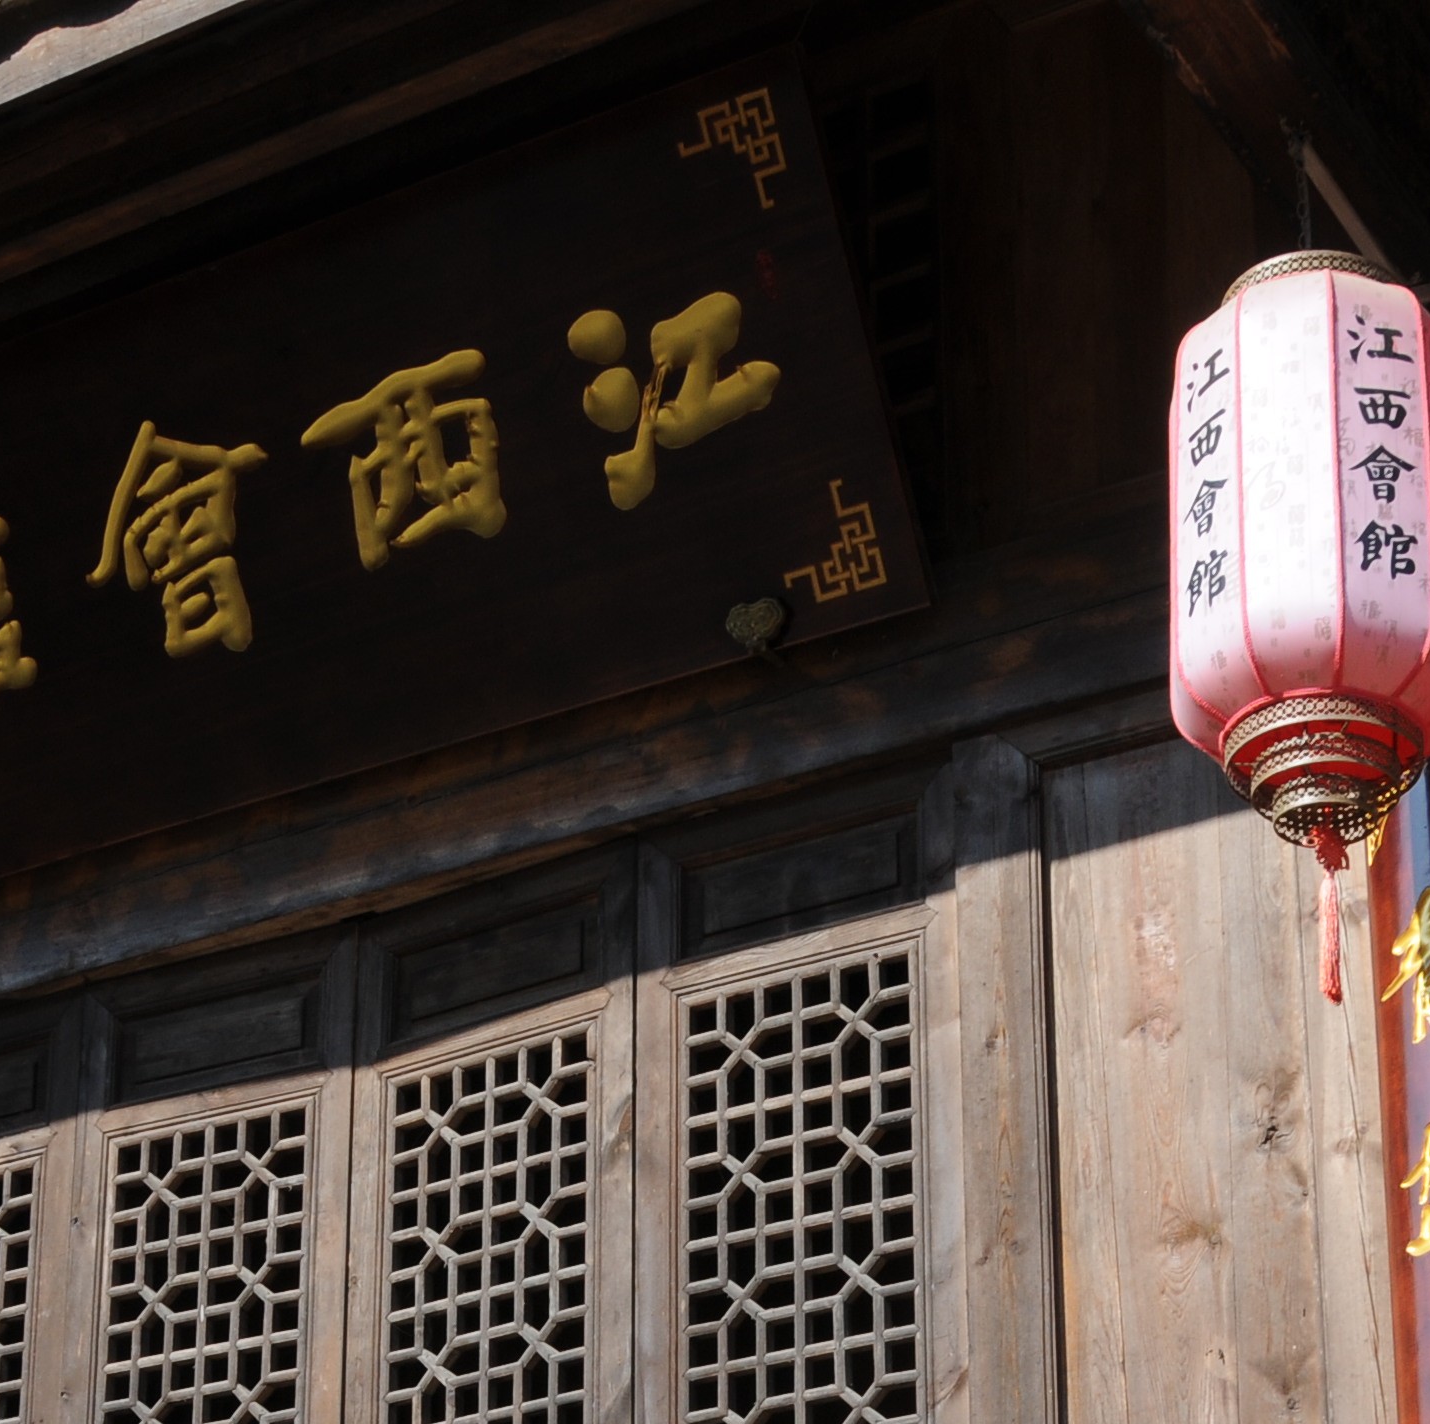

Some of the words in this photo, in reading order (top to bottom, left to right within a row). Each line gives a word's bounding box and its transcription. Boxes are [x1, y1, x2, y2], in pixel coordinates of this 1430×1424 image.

[1185, 347, 1231, 618] 江西會館
[1346, 315, 1419, 581] 江西會館
